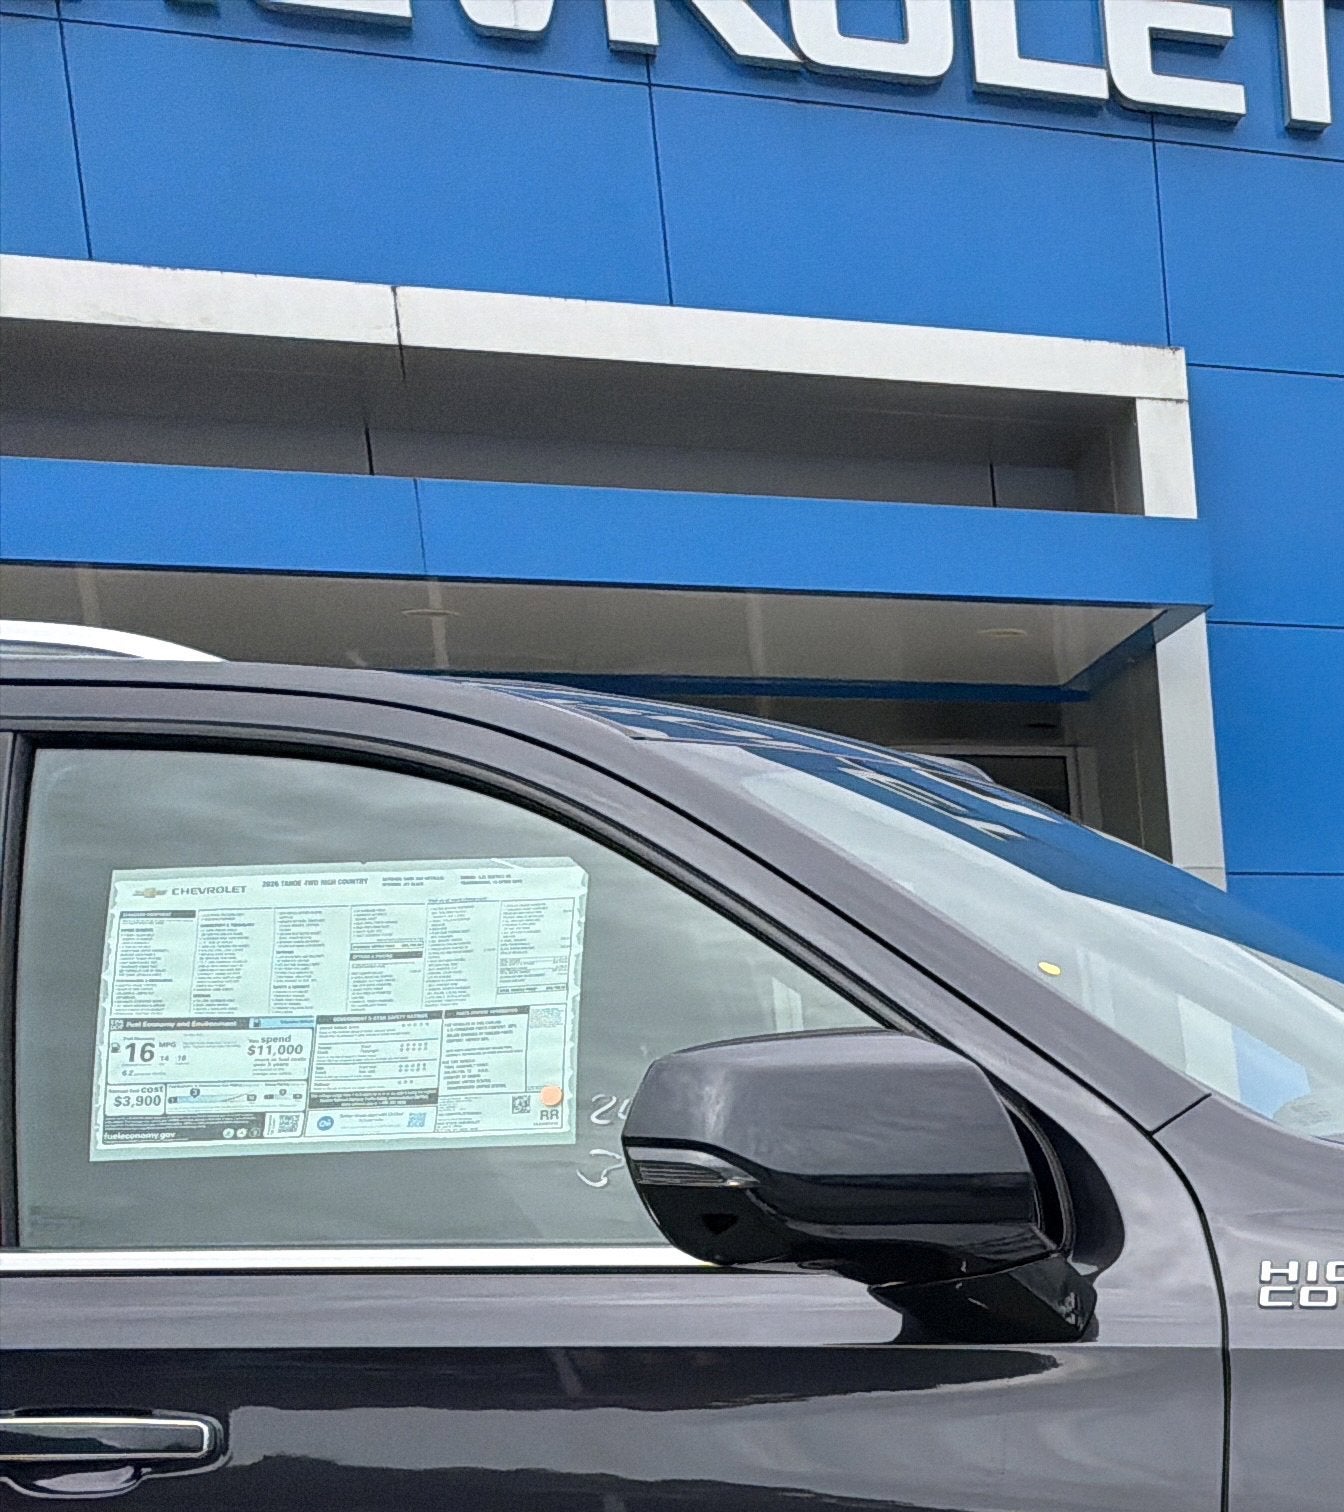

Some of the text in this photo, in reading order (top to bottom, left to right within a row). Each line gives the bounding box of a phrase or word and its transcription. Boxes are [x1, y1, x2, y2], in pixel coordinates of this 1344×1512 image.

[171, 885, 248, 896] CHEVROLET
[260, 1034, 292, 1045] spend
[125, 1042, 156, 1063] 16
[247, 1044, 304, 1057] $11,000
[113, 1095, 162, 1108] $3,900
